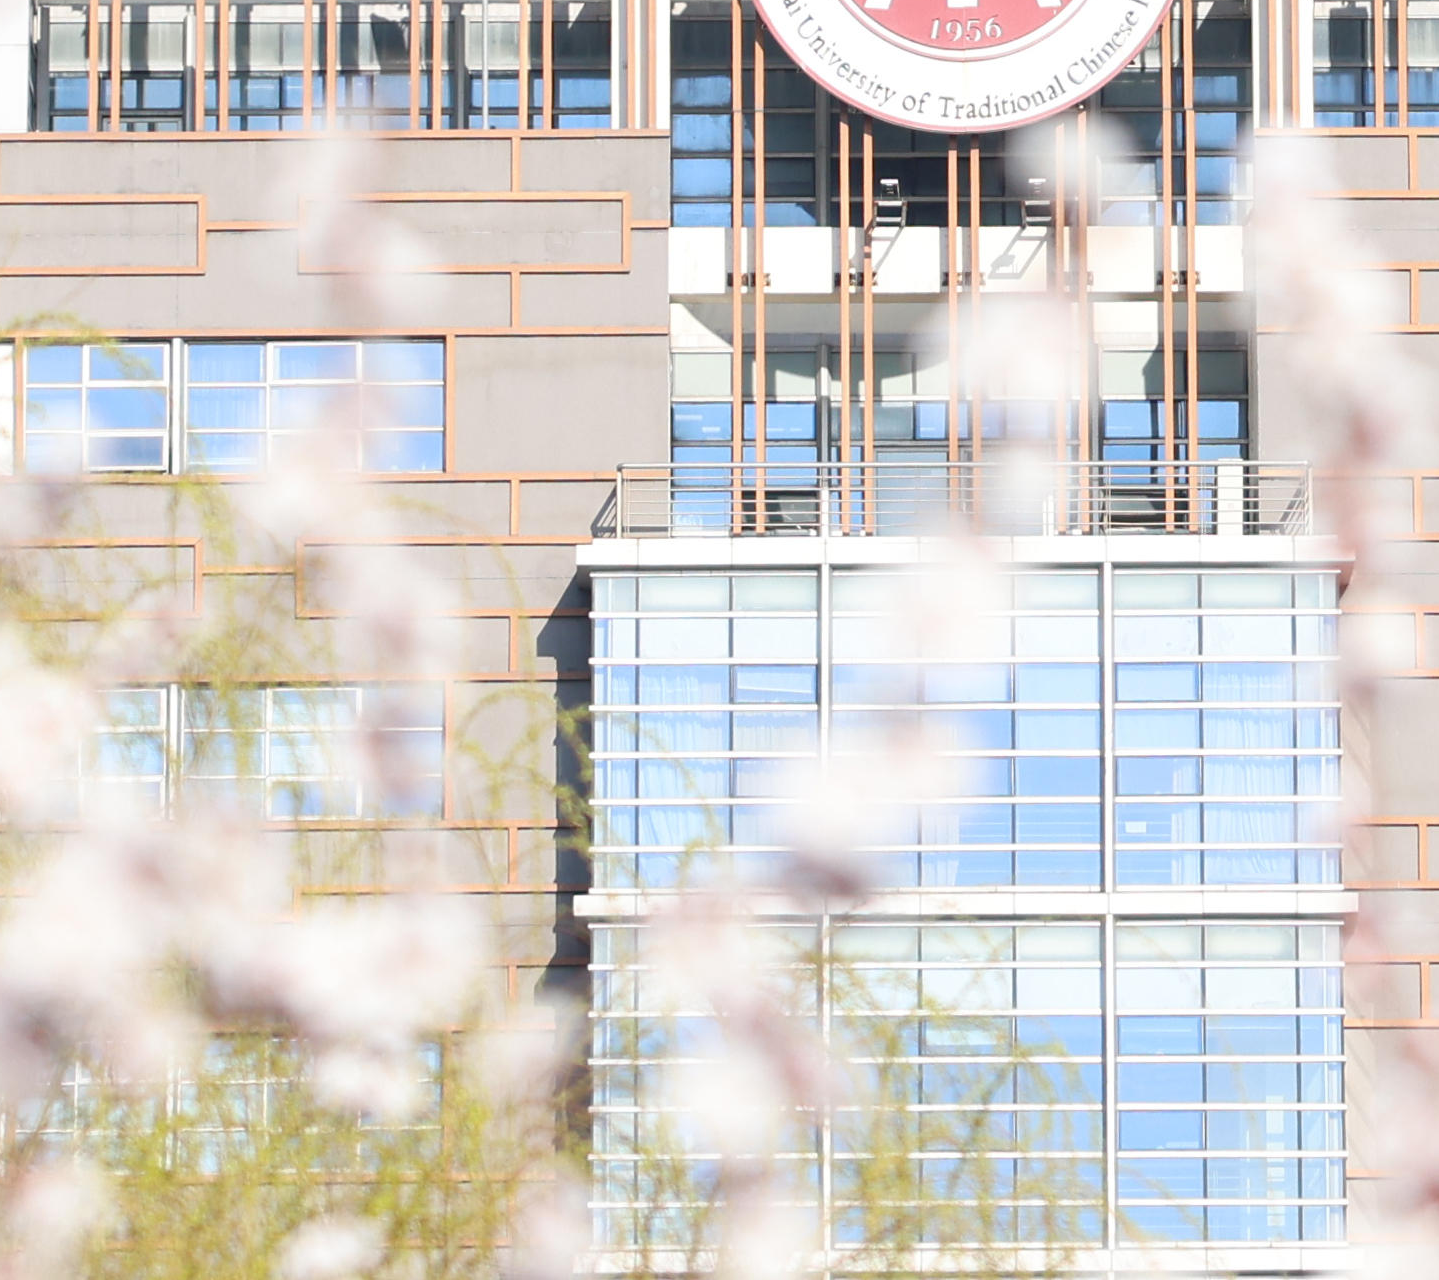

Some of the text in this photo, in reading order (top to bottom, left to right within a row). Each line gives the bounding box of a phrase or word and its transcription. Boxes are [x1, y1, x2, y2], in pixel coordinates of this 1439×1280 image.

[928, 14, 1003, 42] 1956
[797, 14, 897, 107] University
[902, 92, 932, 115] of
[937, 74, 1067, 120] Traditional
[1066, 10, 1140, 86] Chinese
